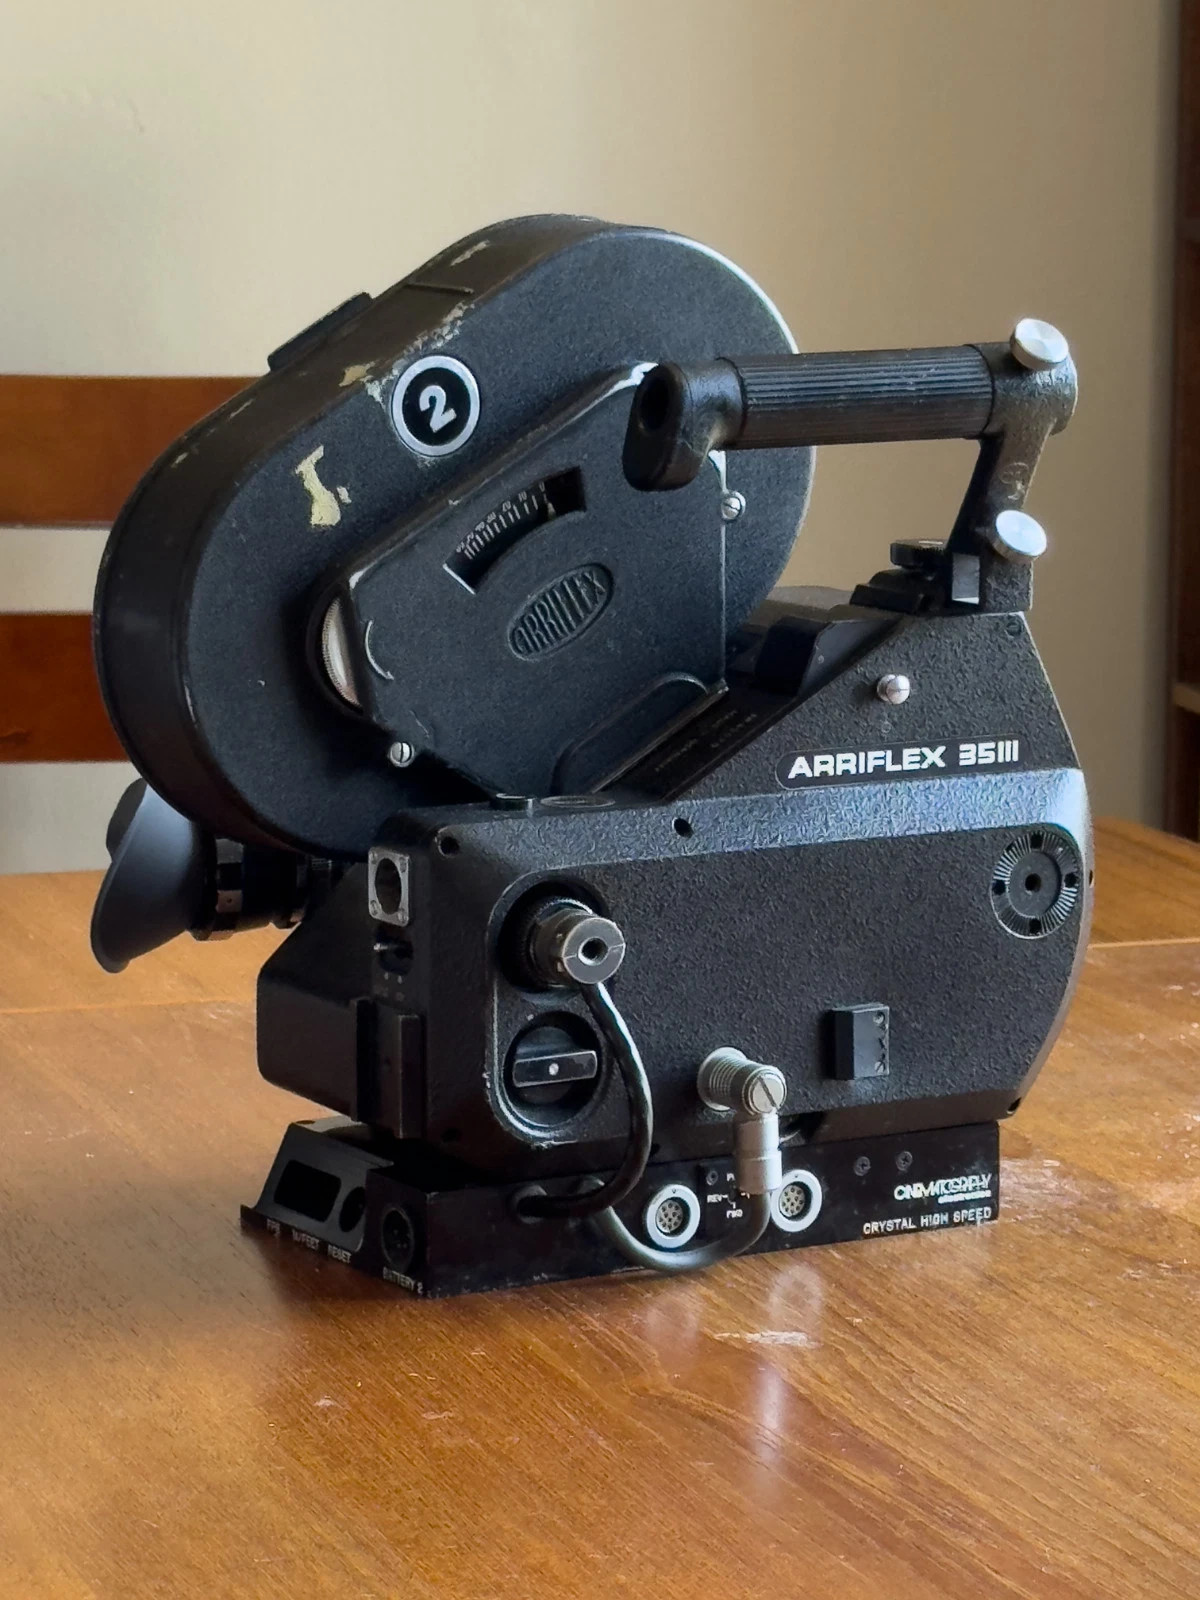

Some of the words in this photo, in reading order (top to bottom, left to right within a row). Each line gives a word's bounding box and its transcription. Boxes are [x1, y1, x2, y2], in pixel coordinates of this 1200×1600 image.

[419, 385, 457, 433] 2
[787, 746, 947, 779] ARRIFLEX
[863, 1217, 917, 1235] CRYSTAL
[920, 1212, 949, 1227] HIGH
[953, 1206, 992, 1223] SPEED
